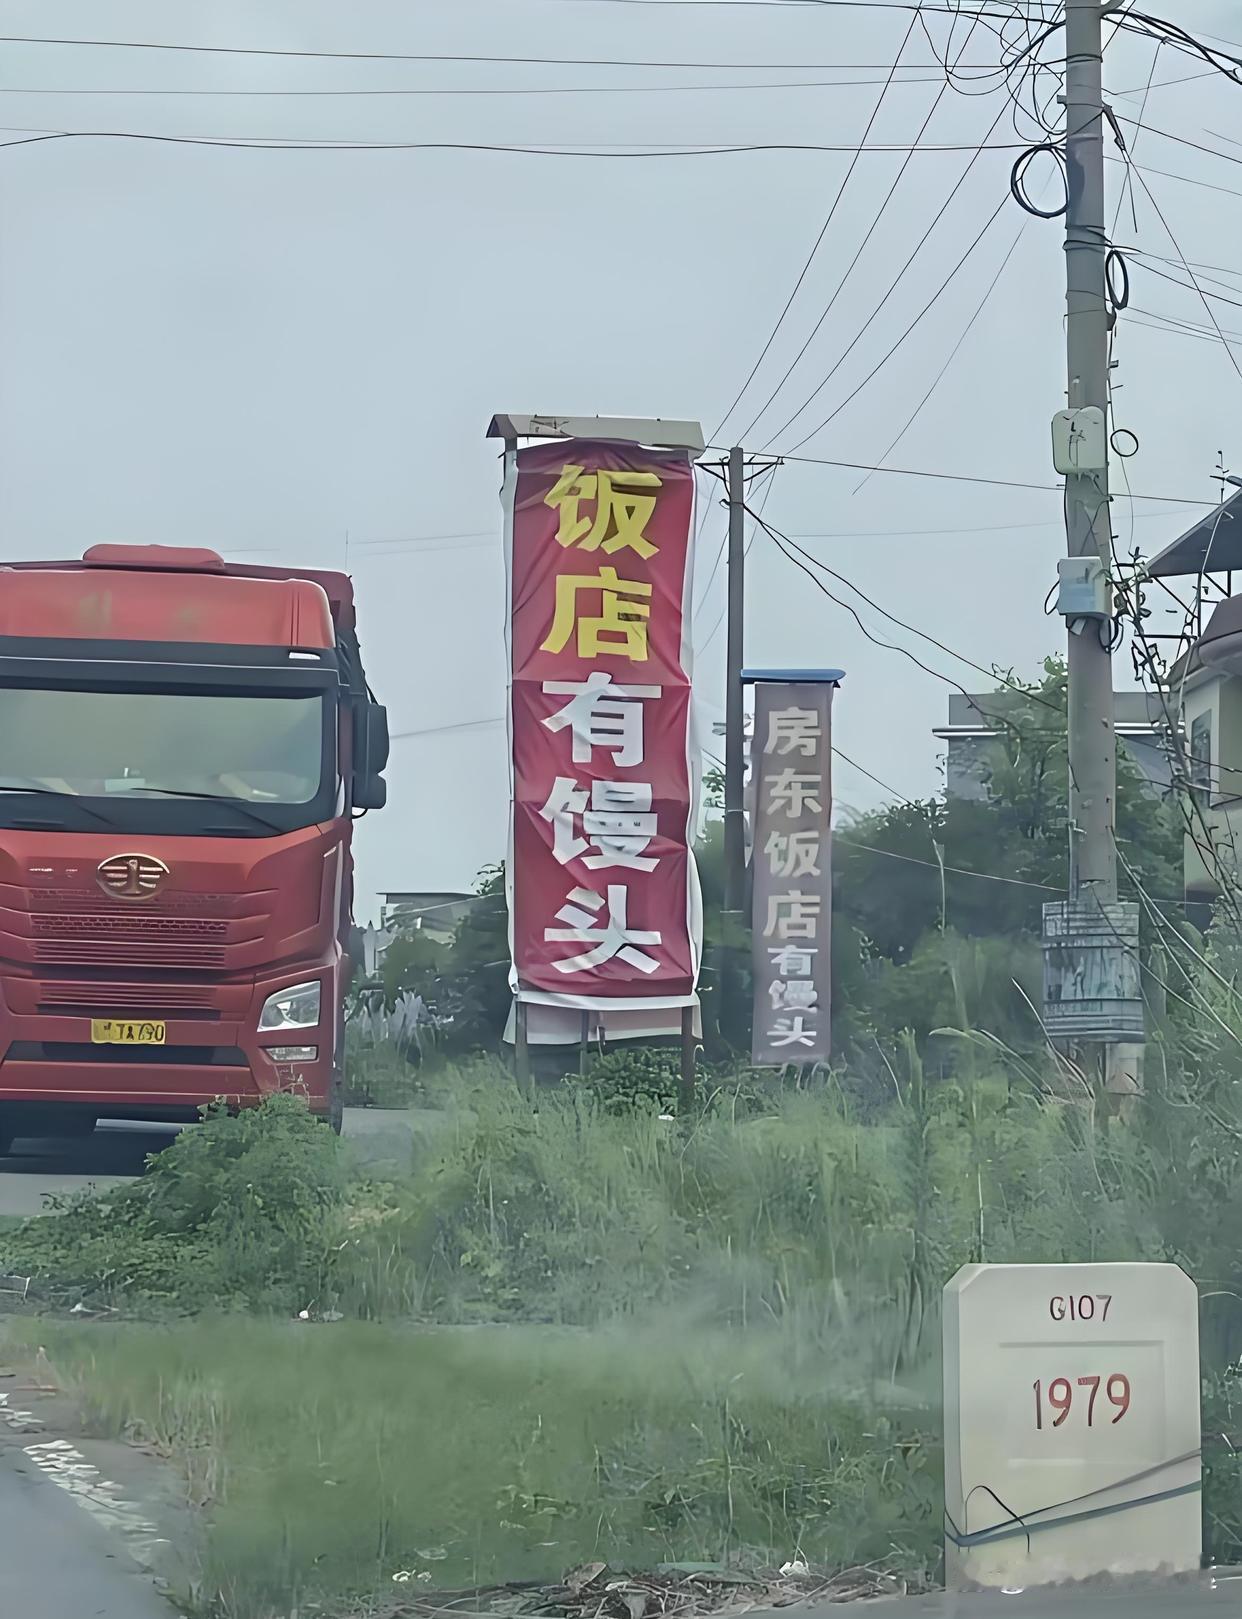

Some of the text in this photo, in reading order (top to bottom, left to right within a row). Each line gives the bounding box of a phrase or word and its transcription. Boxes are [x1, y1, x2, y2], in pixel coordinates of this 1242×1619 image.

[539, 464, 663, 975] 饭店有馒头
[763, 706, 823, 1047] 房东饭店有馒头
[1033, 1373, 1131, 1430] 1979
[1050, 1294, 1113, 1322] G107
